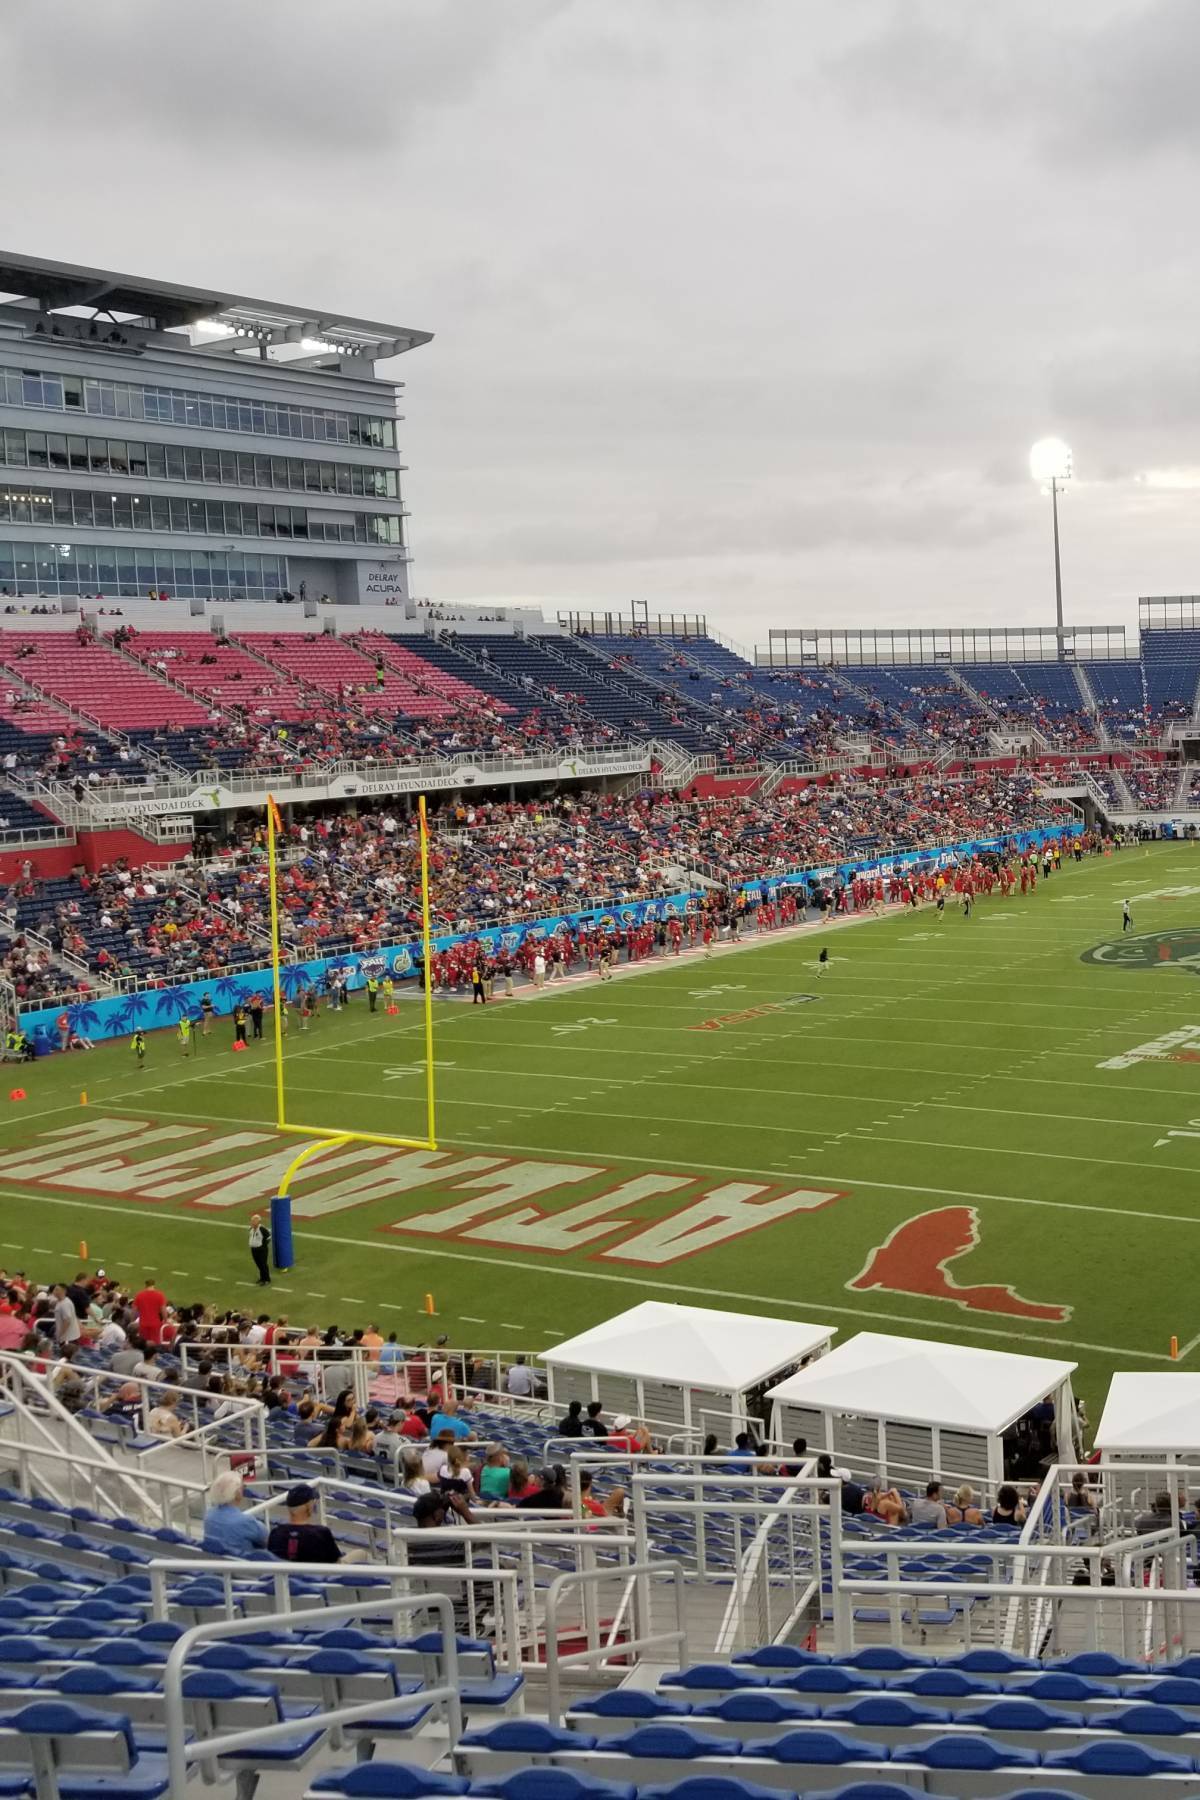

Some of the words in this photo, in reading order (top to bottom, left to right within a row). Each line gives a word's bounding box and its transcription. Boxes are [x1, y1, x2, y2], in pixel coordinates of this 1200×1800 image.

[368, 573, 399, 582] DELRAY
[366, 584, 402, 593] ACURA
[362, 783, 396, 793] DELRAY
[397, 780, 436, 790] HYUNDAI
[437, 777, 460, 786] DECK
[134, 801, 178, 813] HYUNDAI
[180, 799, 206, 809] DECK
